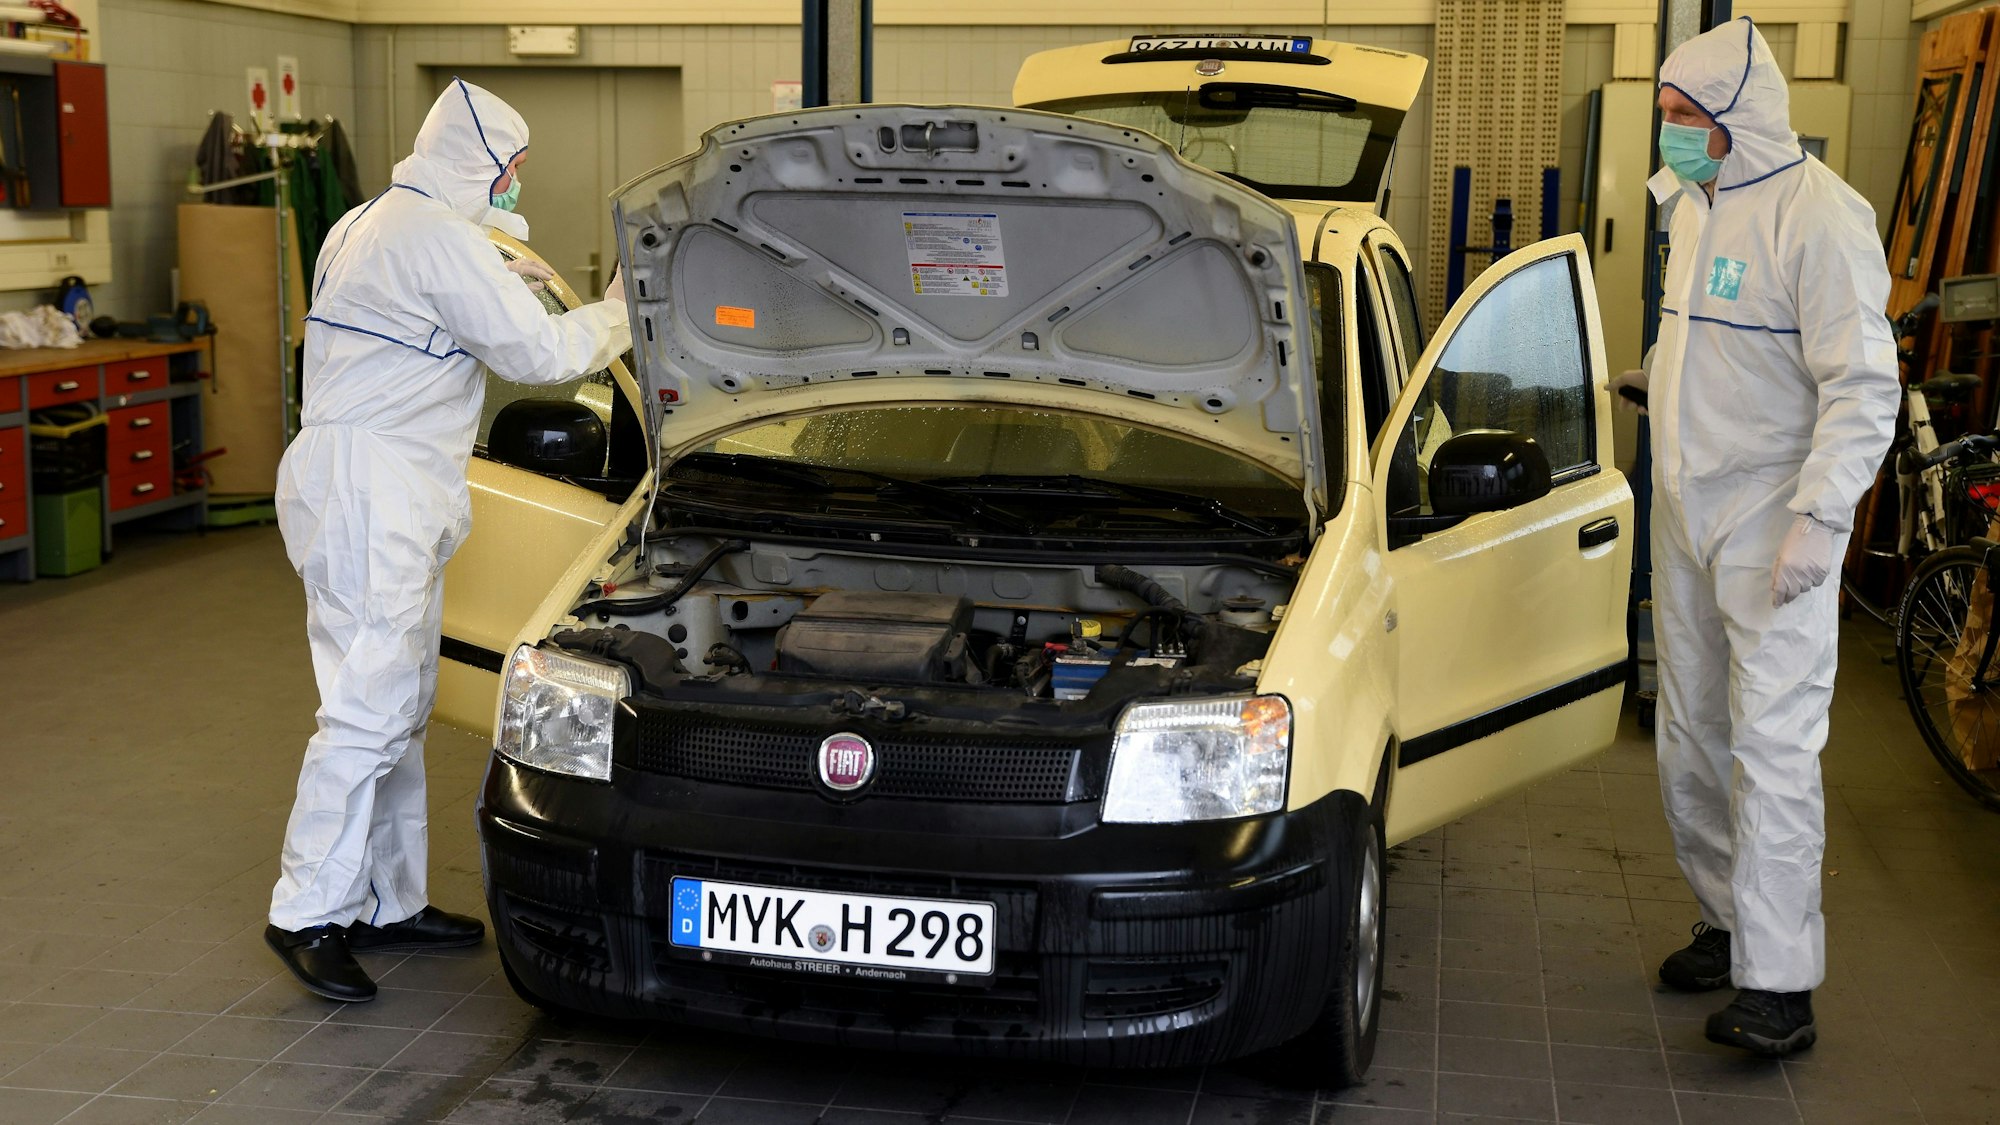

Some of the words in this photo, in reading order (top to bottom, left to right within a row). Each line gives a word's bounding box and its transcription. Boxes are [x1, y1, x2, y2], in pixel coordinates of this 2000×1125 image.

[1896, 575, 1920, 648] SCHWALBE
[829, 748, 863, 777] FIAT
[681, 918, 693, 933] D
[707, 890, 805, 948] MYK
[841, 903, 872, 954] H
[886, 907, 984, 962] 298
[750, 957, 793, 970] Autohaus
[794, 961, 841, 974] STREIER
[855, 967, 906, 979] Andernach
